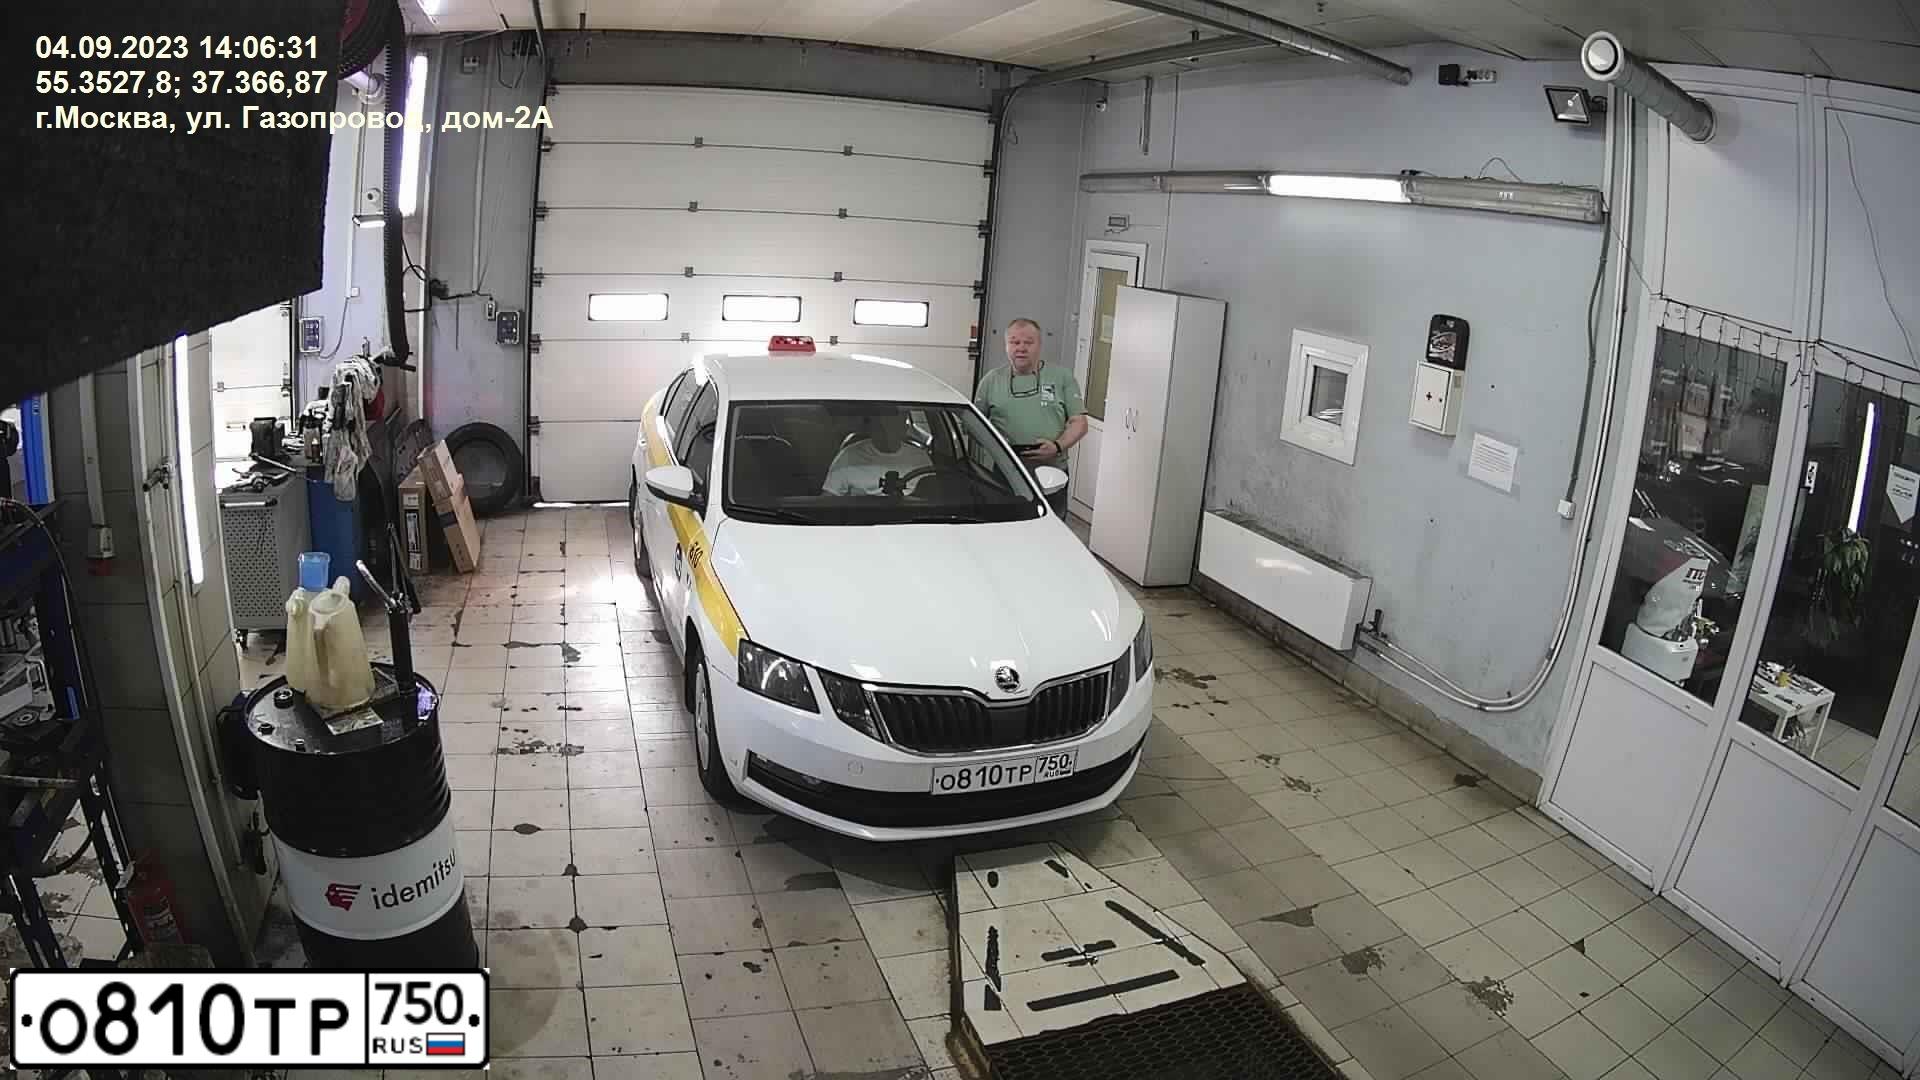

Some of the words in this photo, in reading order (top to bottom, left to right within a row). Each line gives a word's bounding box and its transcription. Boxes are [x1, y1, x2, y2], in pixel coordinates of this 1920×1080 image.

[940, 764, 1032, 791] О810ТР
[1039, 754, 1069, 774] 750
[371, 849, 456, 910] idemitsu
